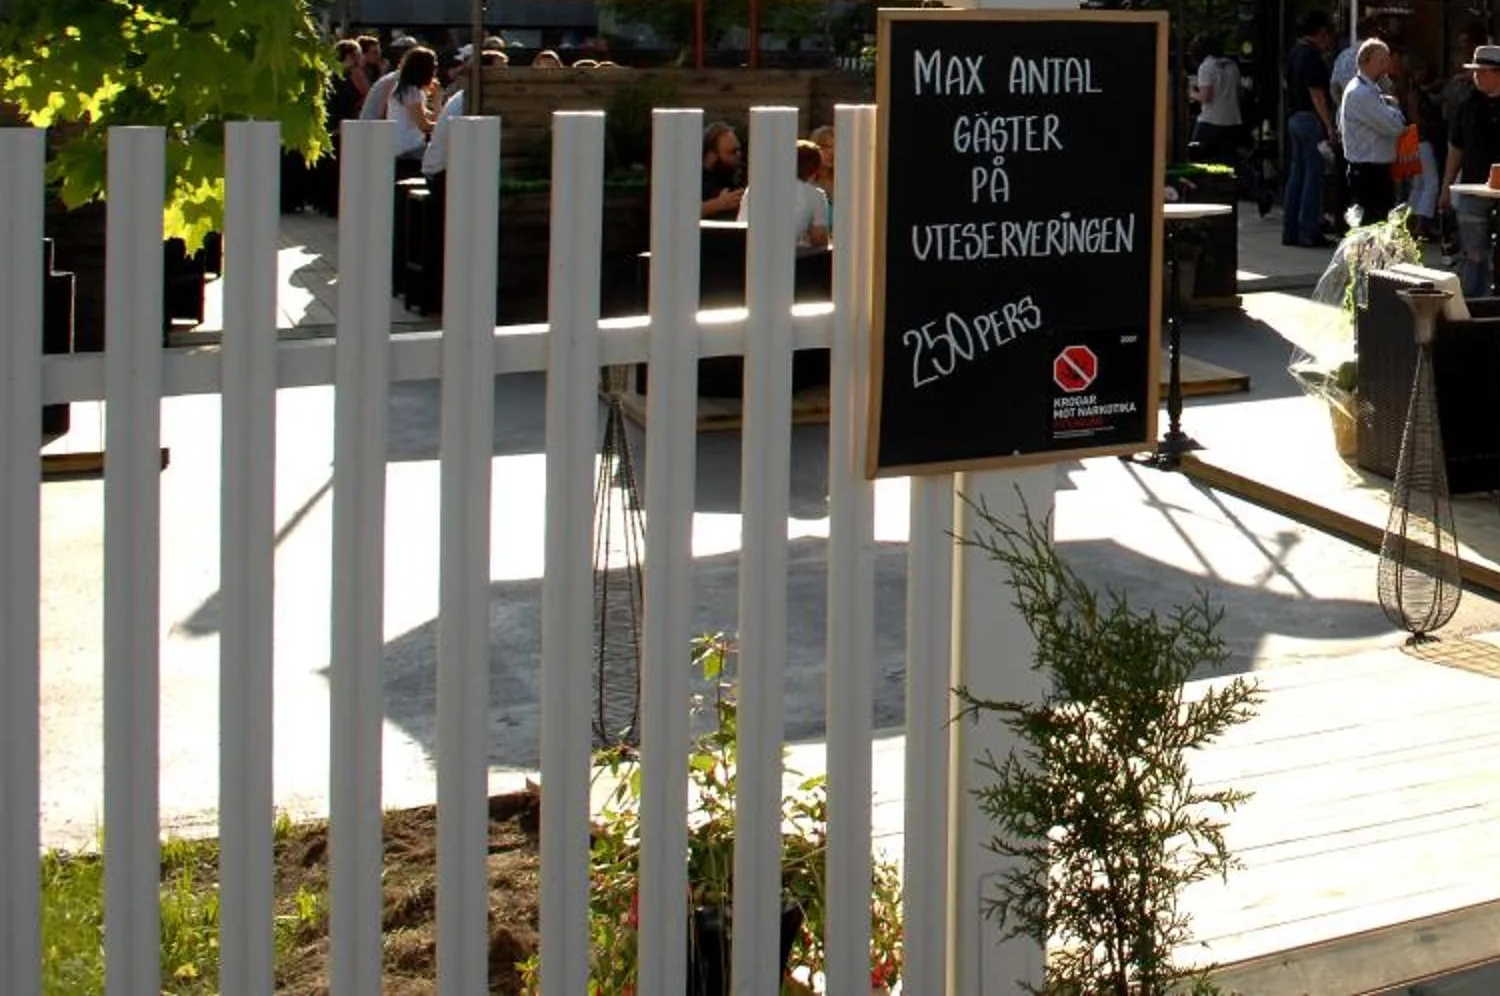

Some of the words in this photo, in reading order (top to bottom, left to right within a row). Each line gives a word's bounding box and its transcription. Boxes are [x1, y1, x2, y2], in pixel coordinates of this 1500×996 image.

[914, 49, 984, 96] MAX
[1009, 56, 1102, 95] ANTAL
[953, 112, 1063, 153] GÄSTER
[972, 156, 1010, 203] PÅ
[912, 210, 1135, 261] UTESERVERINGEN
[903, 312, 975, 388] 250
[973, 295, 1042, 353] PERS
[1053, 395, 1097, 409] KROGAR
[1053, 407, 1076, 419] MOT
[1077, 402, 1137, 417] NARKOTIKA
